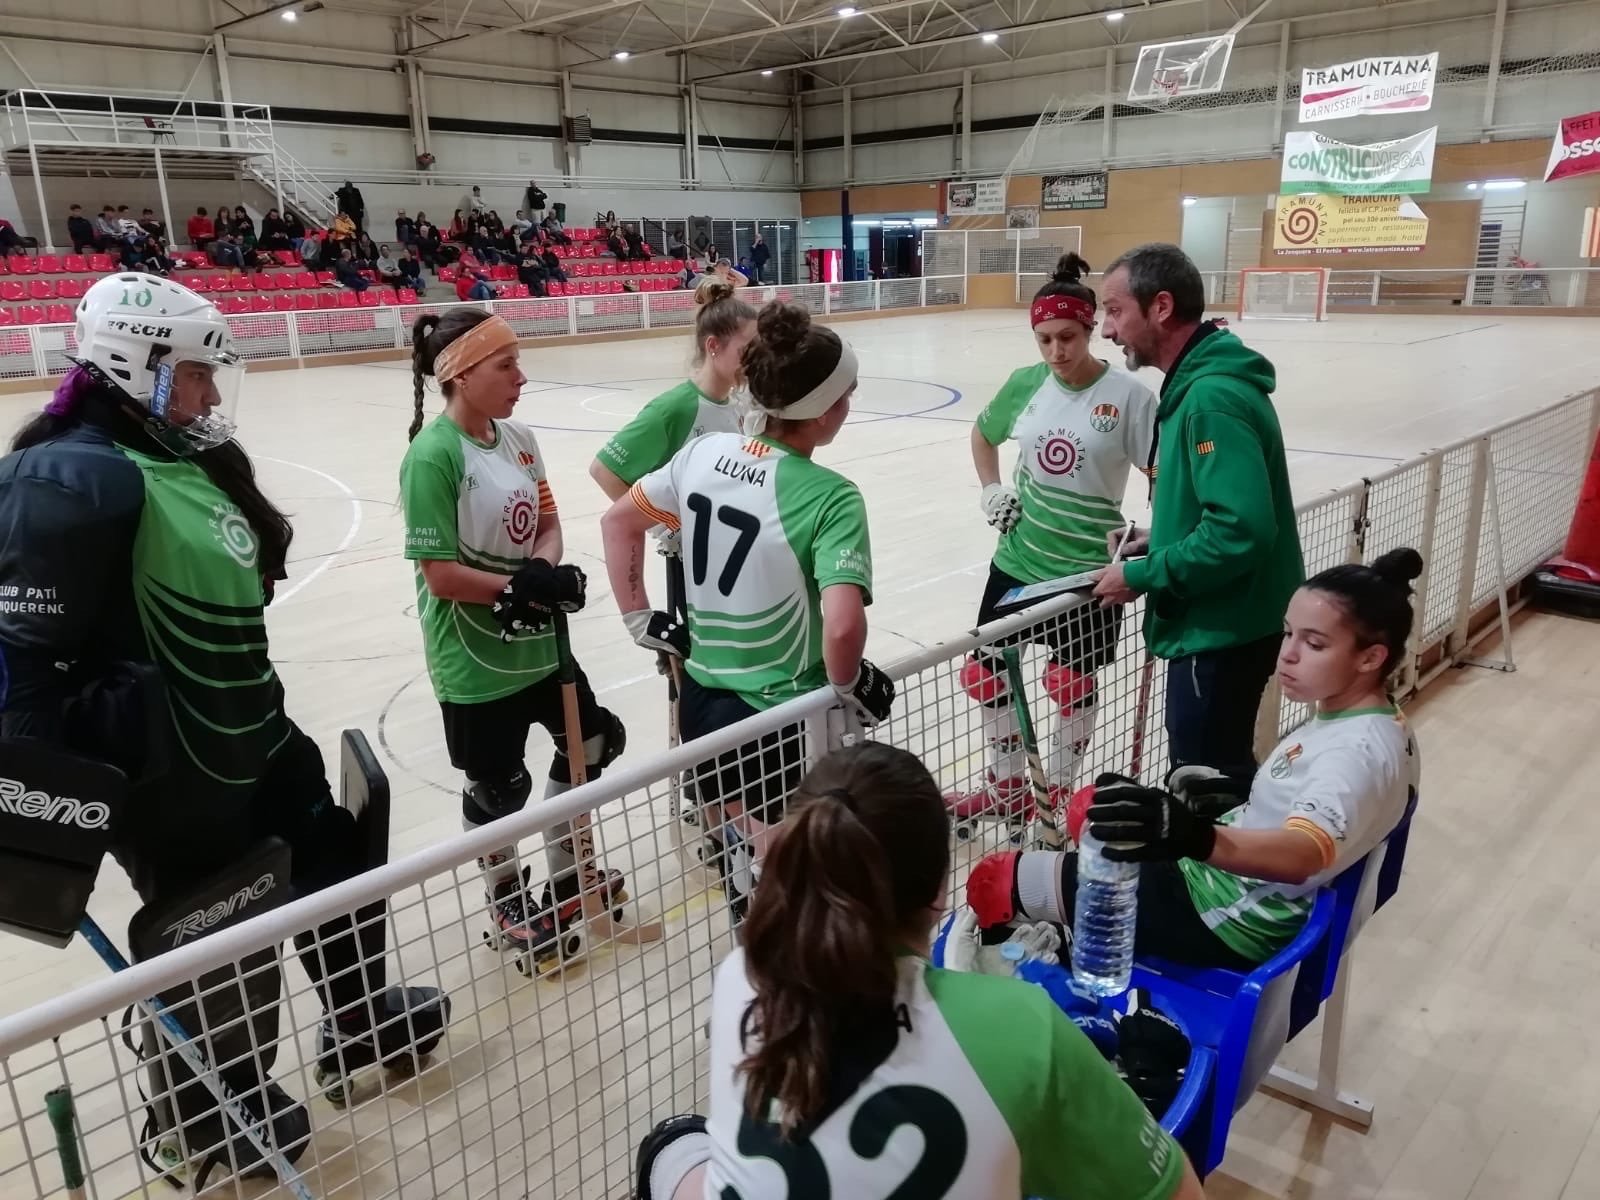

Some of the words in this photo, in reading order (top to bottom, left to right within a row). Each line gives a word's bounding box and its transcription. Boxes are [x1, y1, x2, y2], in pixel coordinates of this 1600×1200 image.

[1306, 58, 1432, 87] TRAMUNTANA
[1305, 96, 1363, 120] CARNISSERI
[1373, 78, 1429, 101] BOUCHERIE
[1278, 197, 1328, 245] TRAMUNTANA
[714, 455, 767, 488] LLUNA
[1034, 428, 1086, 479] TRAMUNTANA
[686, 491, 761, 597] 17
[26, 586, 57, 600] PATÍ
